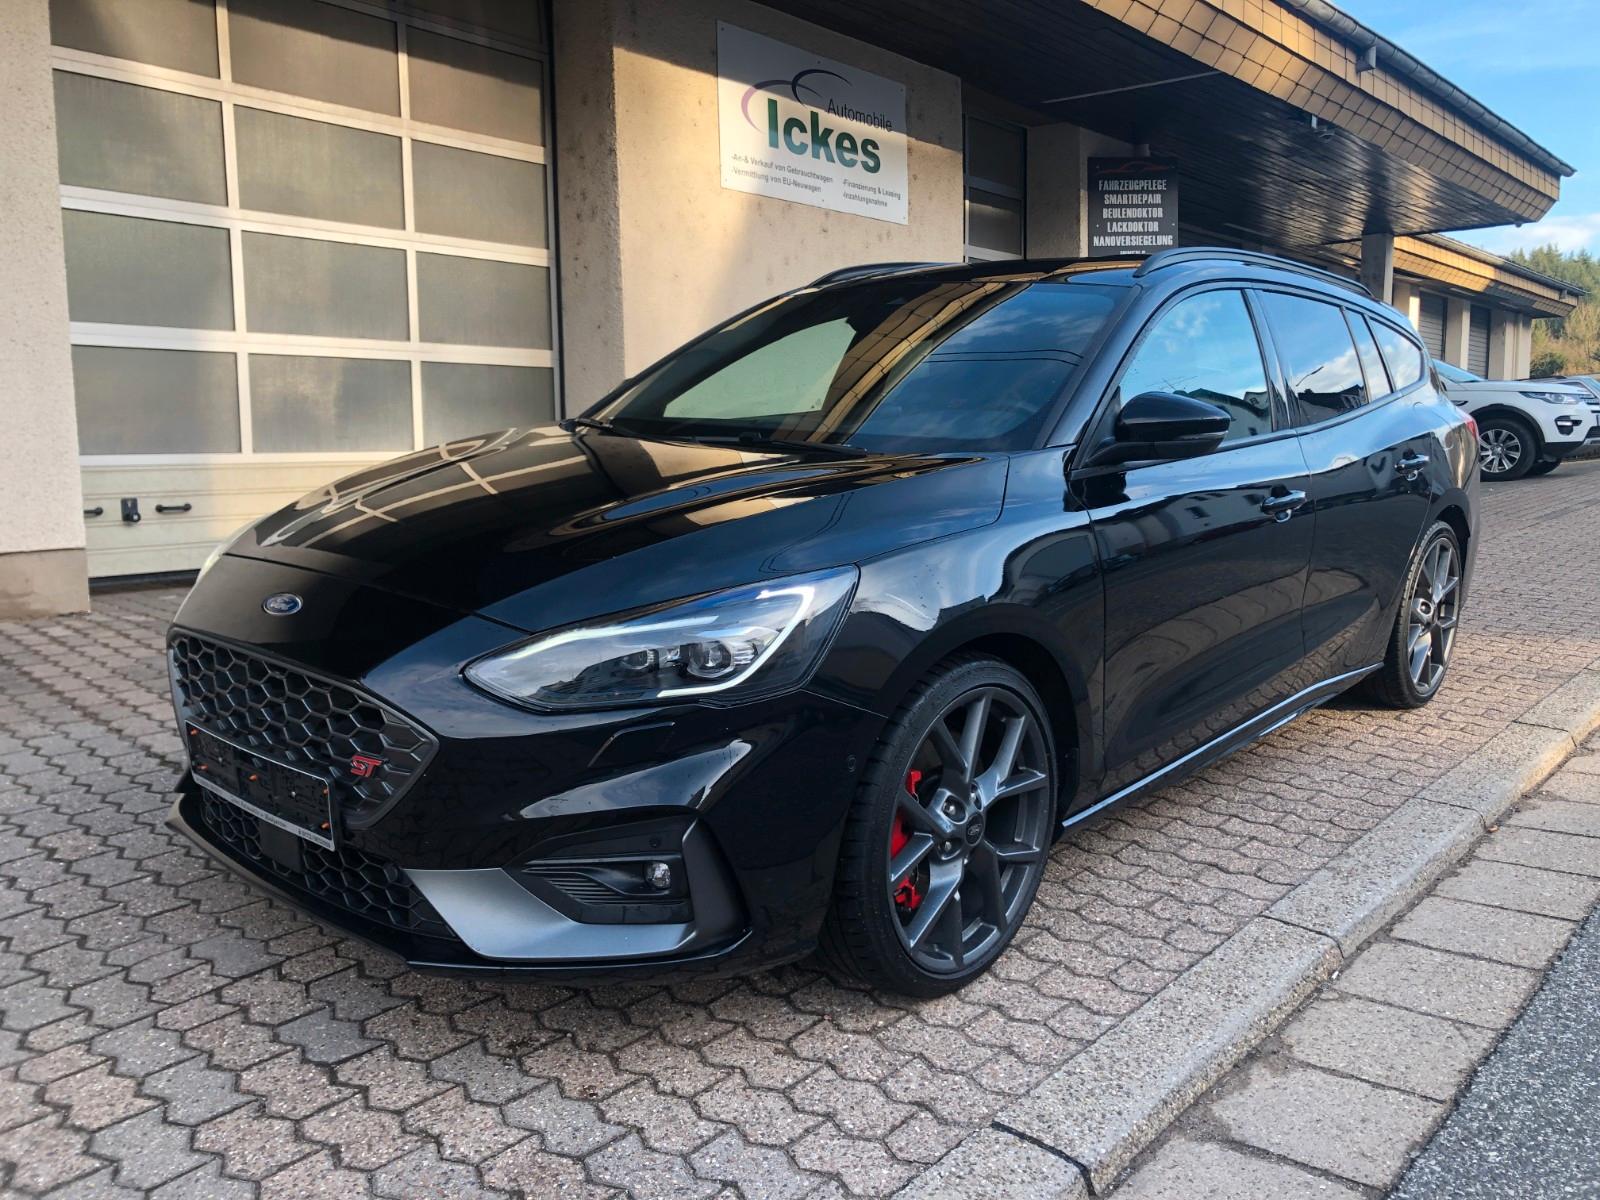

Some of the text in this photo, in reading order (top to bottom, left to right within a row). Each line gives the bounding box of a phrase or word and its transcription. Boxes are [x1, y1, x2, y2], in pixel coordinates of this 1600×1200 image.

[828, 98, 892, 132] Automobile
[767, 97, 881, 174] Ickes
[733, 166, 769, 183] Vermittlung
[770, 175, 782, 184] von
[750, 157, 773, 169] Verkauf
[774, 164, 786, 172] von
[786, 165, 834, 184] Gebrauchtwagen
[1098, 179, 1167, 191] FAHRZEUGPFLEGE
[1104, 193, 1162, 205] SMARTREPAIR
[1102, 207, 1164, 219] BEULENDOKTOR
[1107, 221, 1159, 233] LACKDOKTOR
[1093, 235, 1174, 247] NANOVERSIEGELUNG
[351, 754, 382, 777] ST
